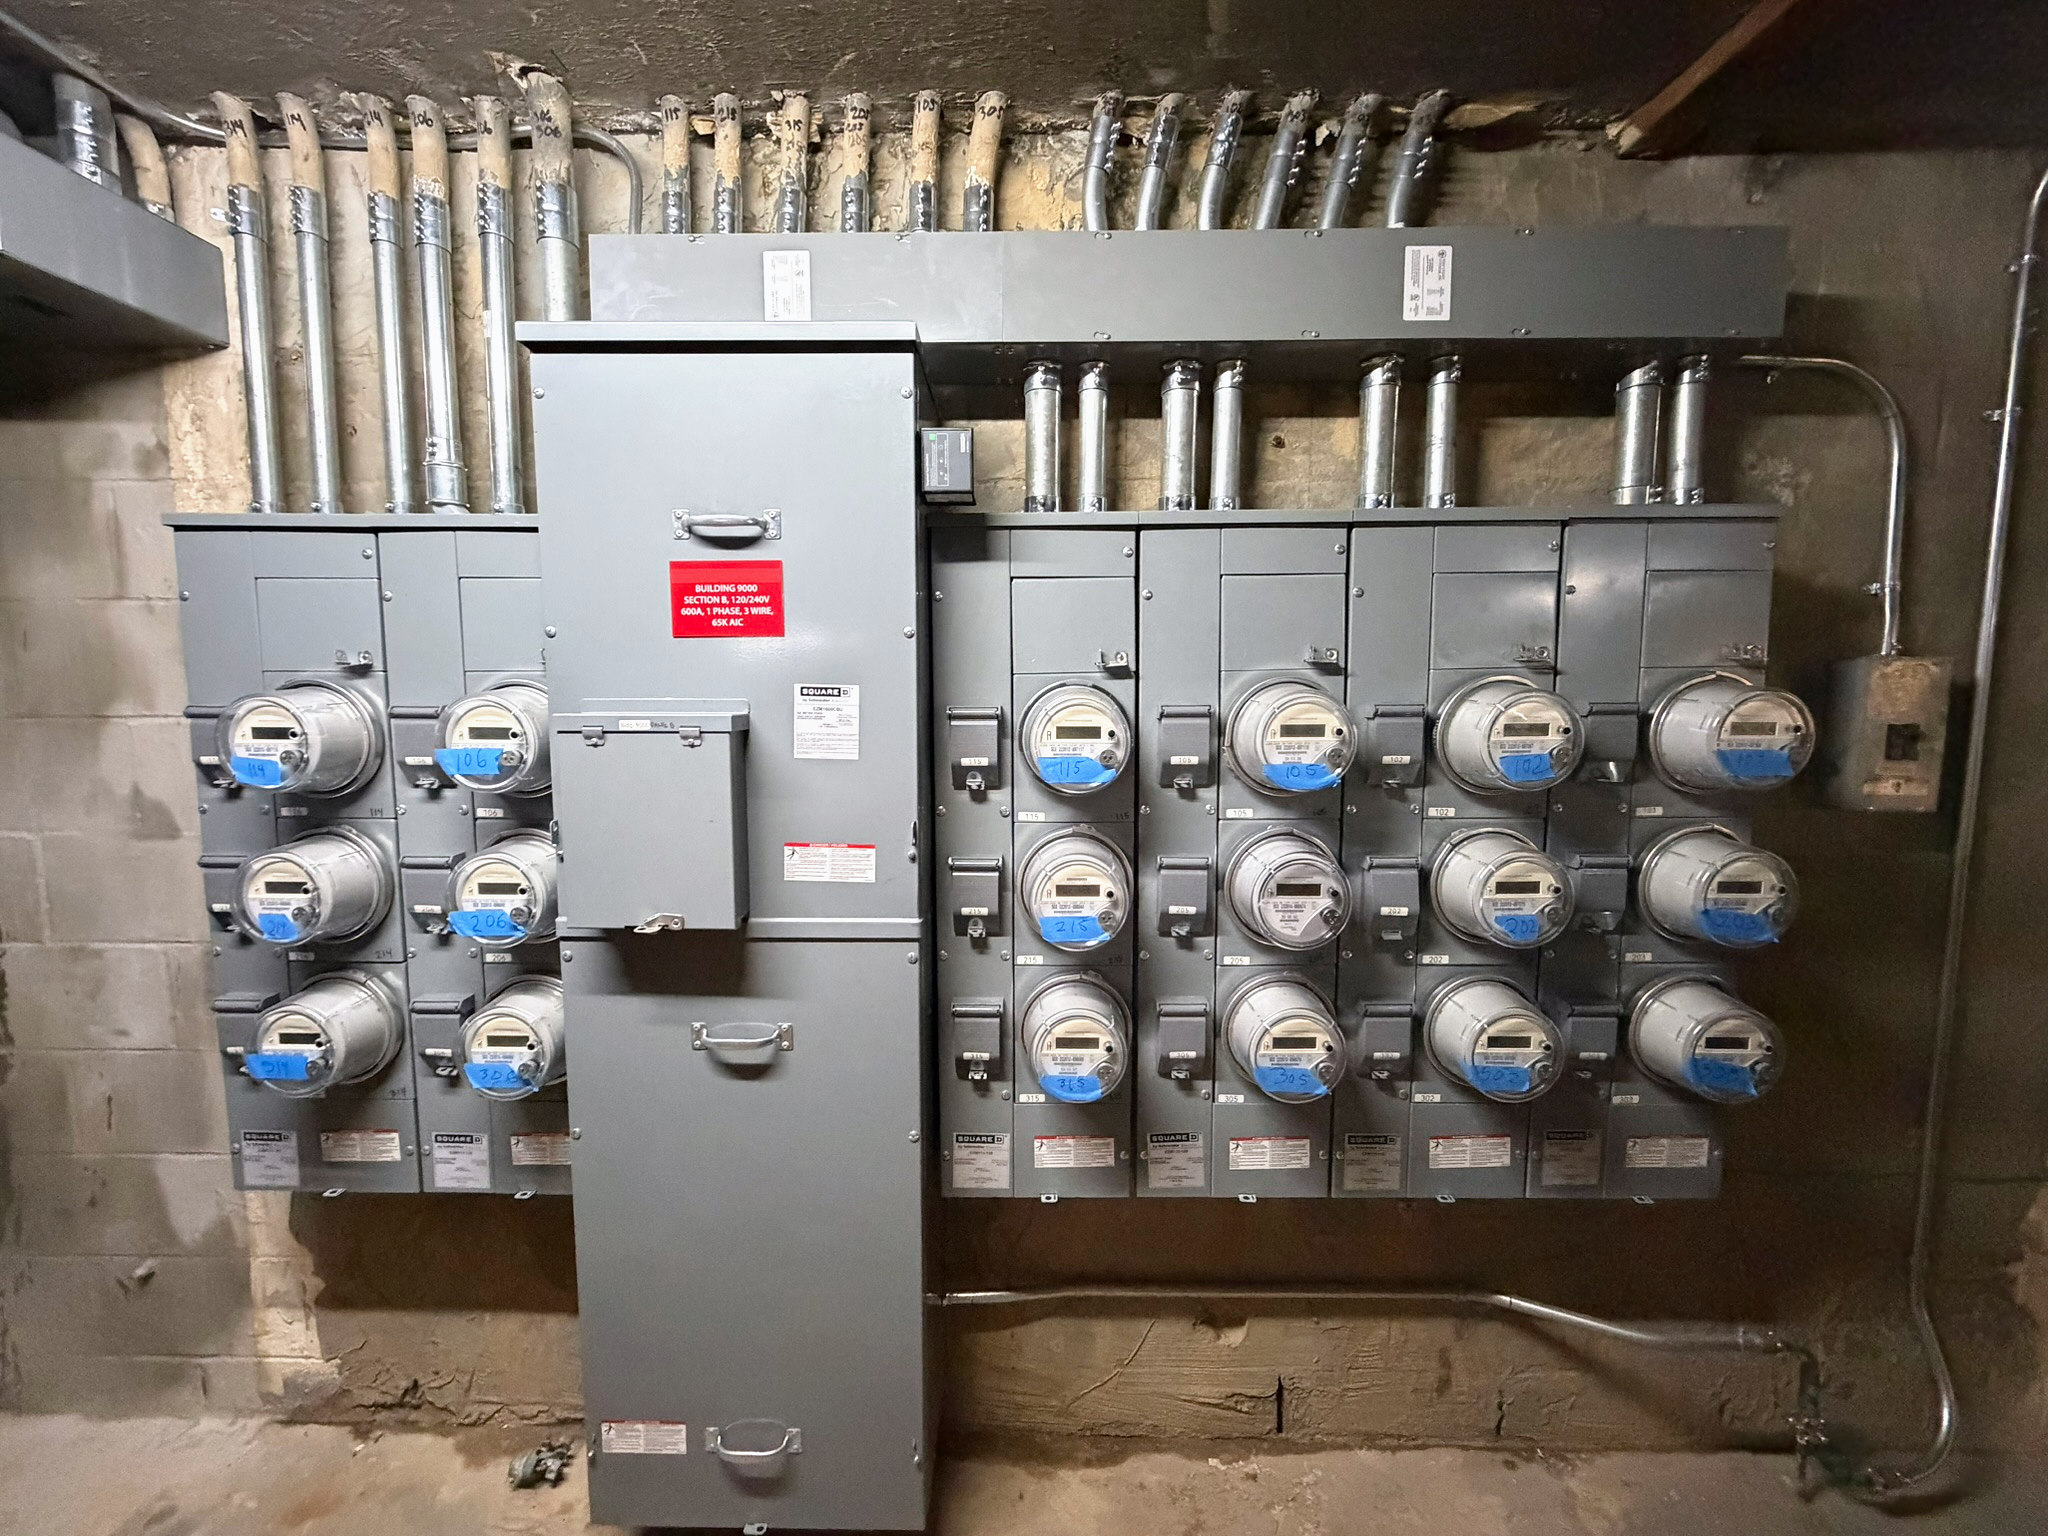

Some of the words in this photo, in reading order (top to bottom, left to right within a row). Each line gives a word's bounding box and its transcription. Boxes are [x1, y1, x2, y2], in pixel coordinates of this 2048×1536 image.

[917, 98, 939, 113] 105
[664, 106, 681, 122] 115
[695, 584, 736, 593] BUILDING
[737, 584, 758, 593] 9000
[684, 595, 722, 604] SECTION
[722, 595, 730, 605] B,
[731, 595, 770, 604] 120/240V
[680, 607, 705, 617] 600A,
[707, 607, 711, 615] 1
[713, 607, 743, 617] PHASE,
[744, 607, 749, 615] 3
[750, 607, 774, 617] WIRE,
[711, 618, 728, 627] 65K
[729, 618, 744, 627] AIC
[801, 687, 840, 696] SQUARE
[456, 750, 488, 772] 106
[1515, 755, 1549, 776] 102
[248, 762, 265, 777] 114
[1057, 760, 1086, 777] 115
[1286, 765, 1318, 779] 105
[483, 809, 498, 817] 106
[1025, 813, 1039, 821] 115
[470, 914, 507, 933] 206
[1055, 919, 1093, 934] 215
[1023, 956, 1037, 964] 215
[1273, 1068, 1309, 1086] 305
[1058, 1078, 1087, 1091] 315
[1026, 1094, 1040, 1102] 315
[1421, 1094, 1435, 1102] 302
[1151, 1134, 1188, 1142] SQUARE
